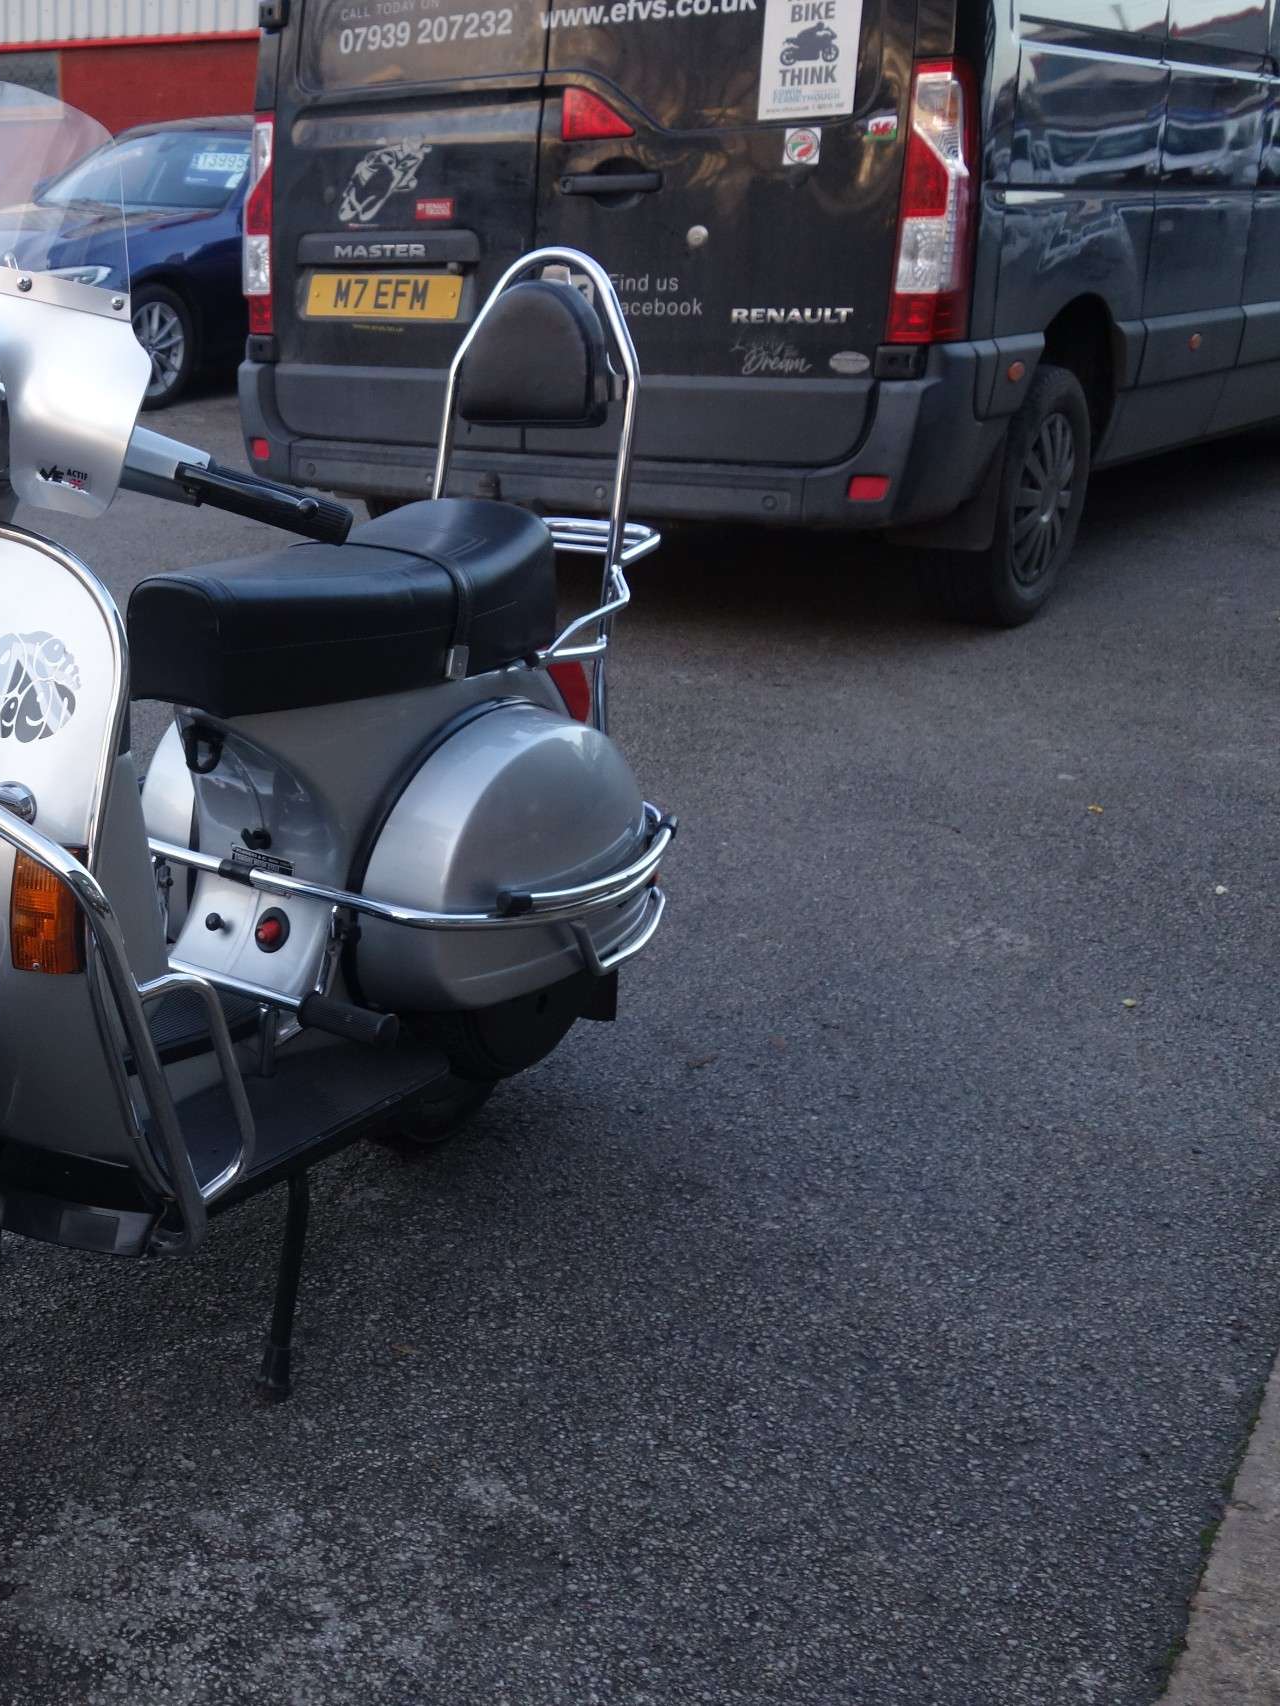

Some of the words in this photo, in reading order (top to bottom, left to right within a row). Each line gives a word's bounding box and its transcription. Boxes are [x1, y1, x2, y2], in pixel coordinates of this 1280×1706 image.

[341, 8, 370, 21] CALL
[376, 0, 415, 15] TODAY
[790, 1, 836, 22] BIKE
[339, 21, 411, 54] 07939
[416, 8, 513, 45] 207232
[779, 65, 837, 86] THINK
[334, 244, 426, 259] MASTER
[333, 279, 369, 309] M7
[373, 279, 430, 310] EFM
[656, 276, 680, 292] us
[621, 298, 703, 316] acebook
[731, 307, 854, 324] RENAULT
